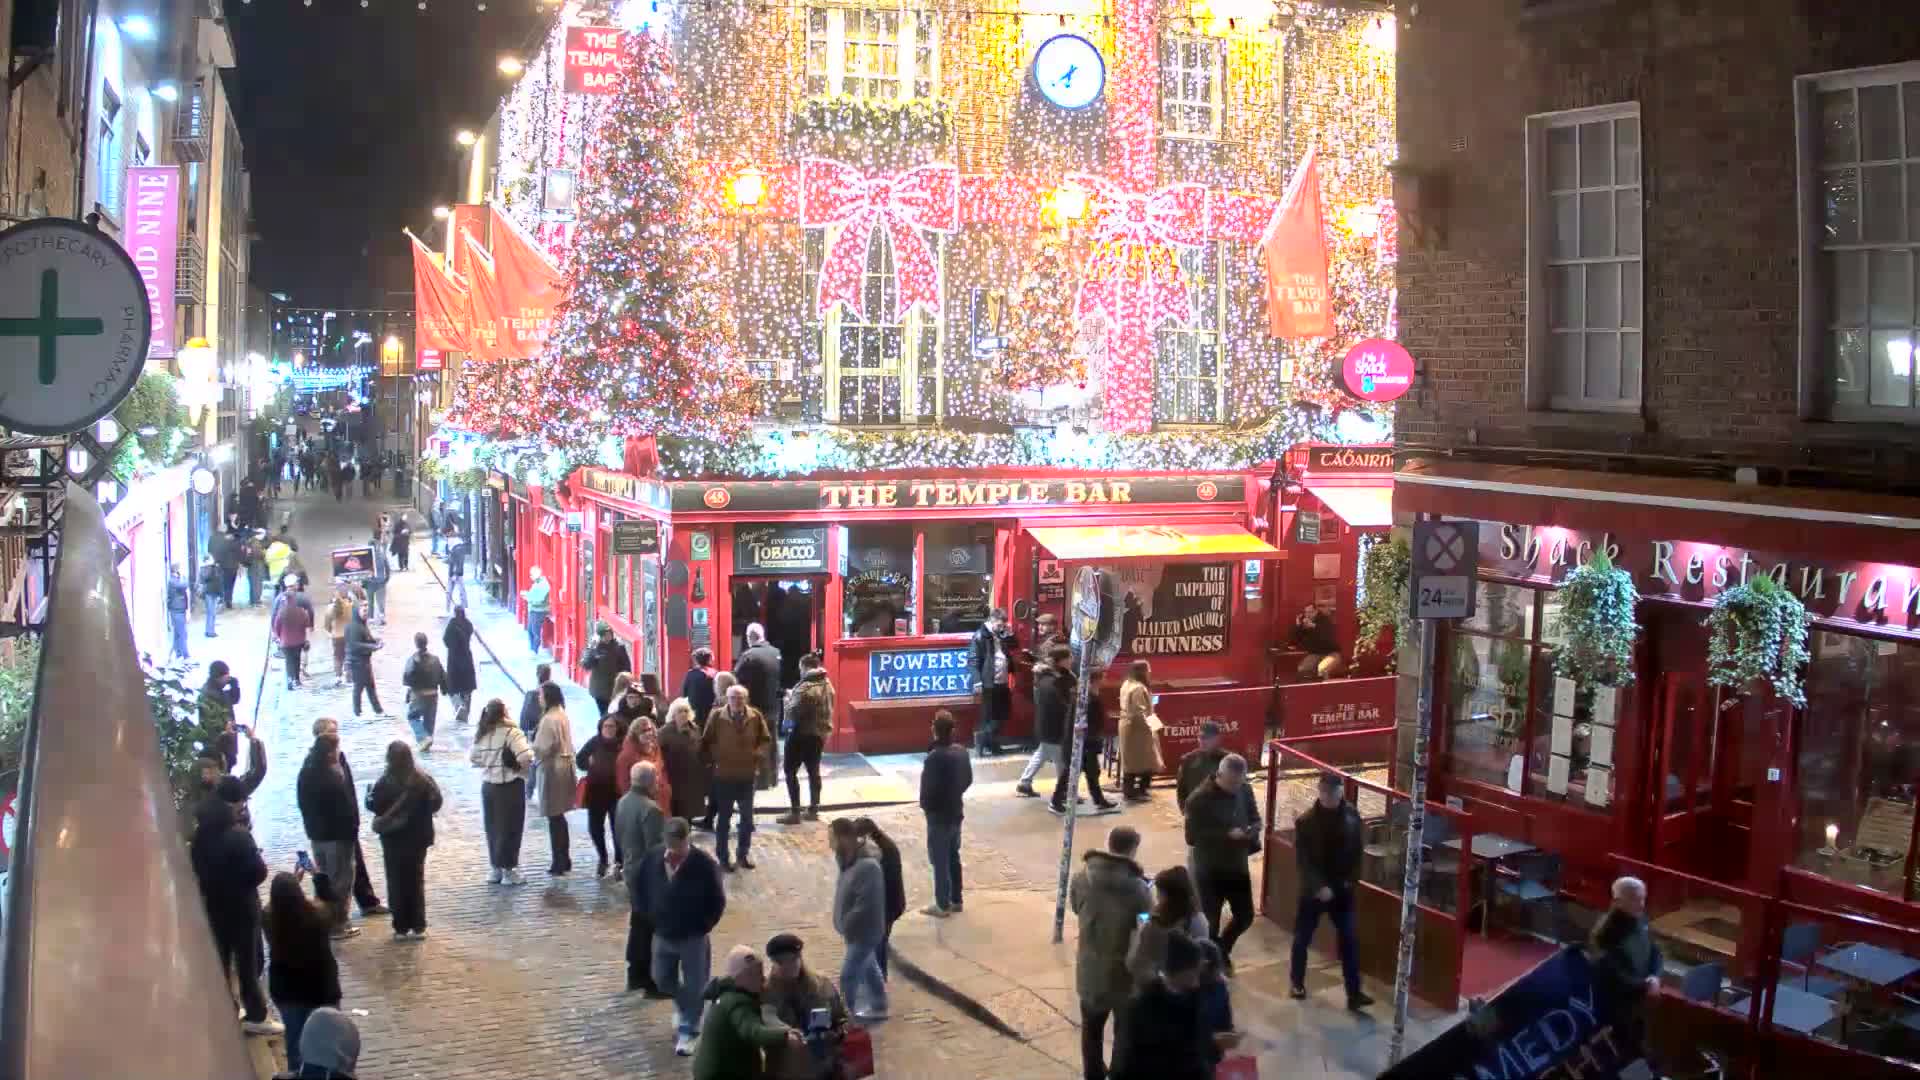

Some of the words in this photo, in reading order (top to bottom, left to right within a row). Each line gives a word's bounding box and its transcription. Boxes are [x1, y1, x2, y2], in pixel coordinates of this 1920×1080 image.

[583, 32, 618, 49] THE
[567, 51, 623, 68] TEMPL
[136, 174, 169, 235] NINE
[1273, 286, 1327, 301] TEMPL
[520, 307, 545, 318] THE
[501, 317, 553, 329] TEMPL
[822, 484, 897, 508] THE
[911, 483, 1049, 506] TEMPLE
[1065, 481, 1132, 504] BAR
[748, 543, 816, 565] TOBACCO
[1499, 524, 1619, 569] Shack
[1202, 566, 1225, 582] THE
[1175, 581, 1225, 597] EMPEROR
[1421, 588, 1442, 605] 24
[1210, 596, 1224, 610] OF
[1137, 619, 1181, 636] MALTED
[1183, 612, 1226, 632] LIQUORS
[1131, 634, 1224, 654] GUINNESS
[879, 651, 969, 671] POWER'S
[873, 673, 973, 694] WHISKEY
[1311, 712, 1355, 724] TEMPLE
